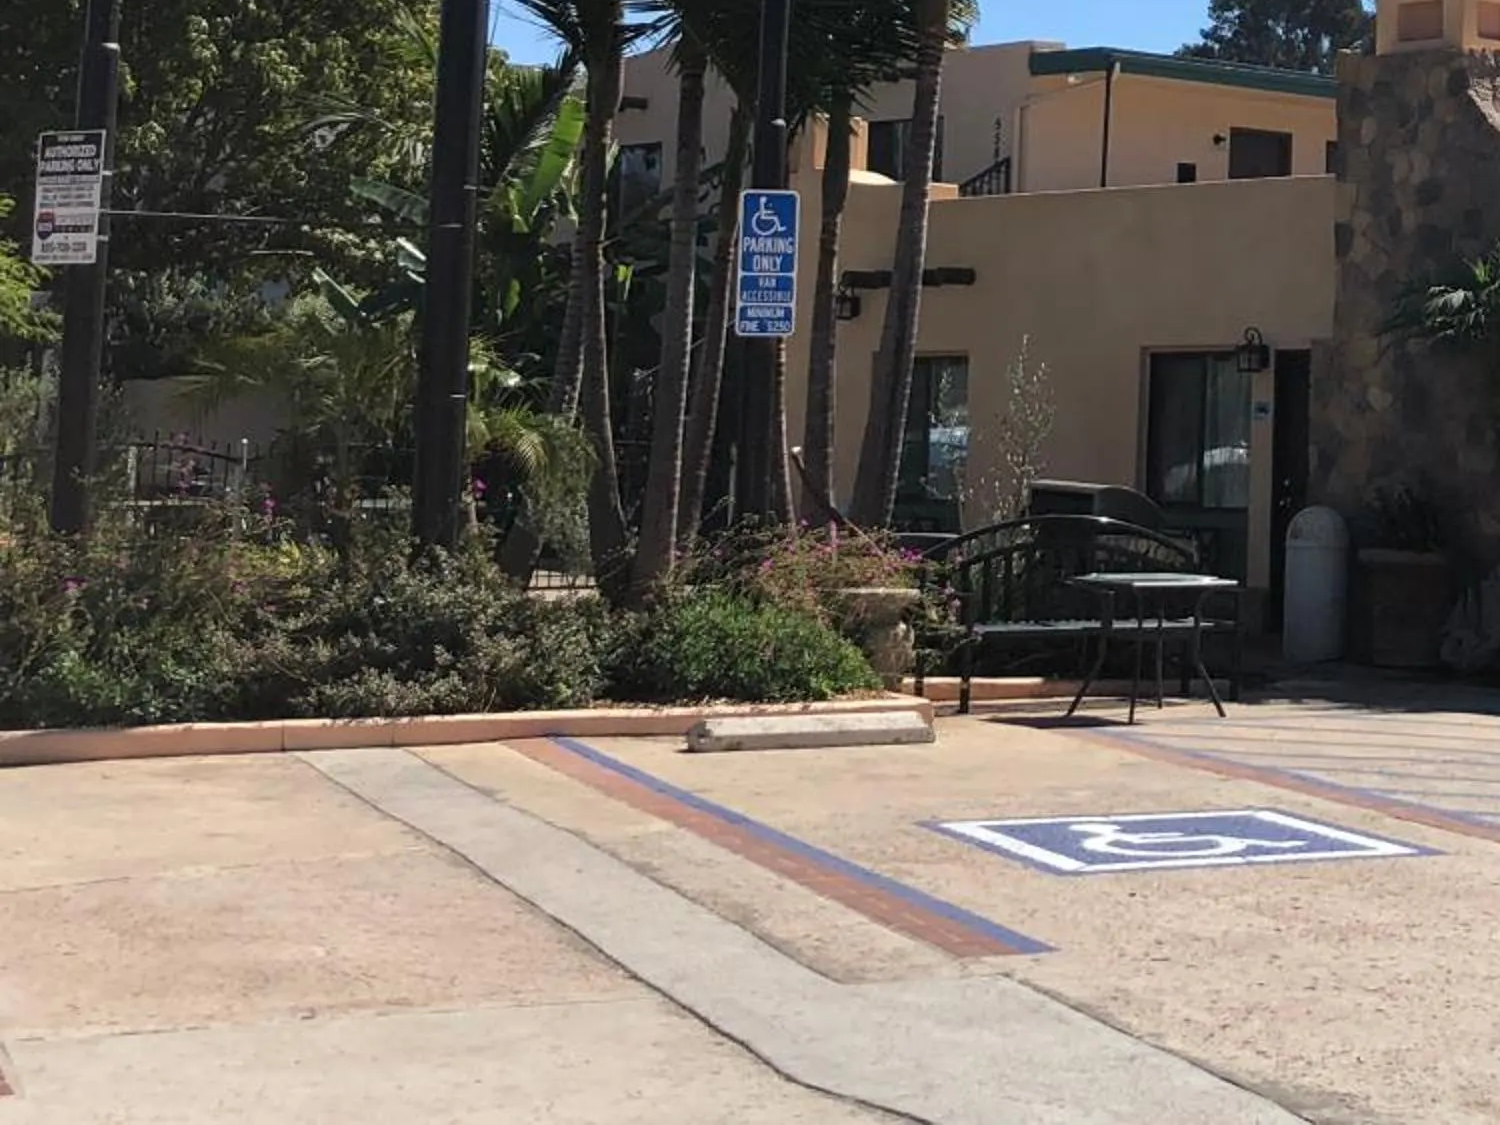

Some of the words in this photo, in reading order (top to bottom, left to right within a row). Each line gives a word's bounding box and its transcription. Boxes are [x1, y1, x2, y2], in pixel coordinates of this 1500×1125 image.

[77, 157, 100, 172] ONLY
[743, 236, 794, 254] PARKING
[752, 254, 783, 272] ONLY
[758, 277, 777, 288] VAN
[742, 290, 791, 302] ACCESSIBLE
[747, 306, 785, 318] MINIMUM
[740, 320, 761, 332] FINE
